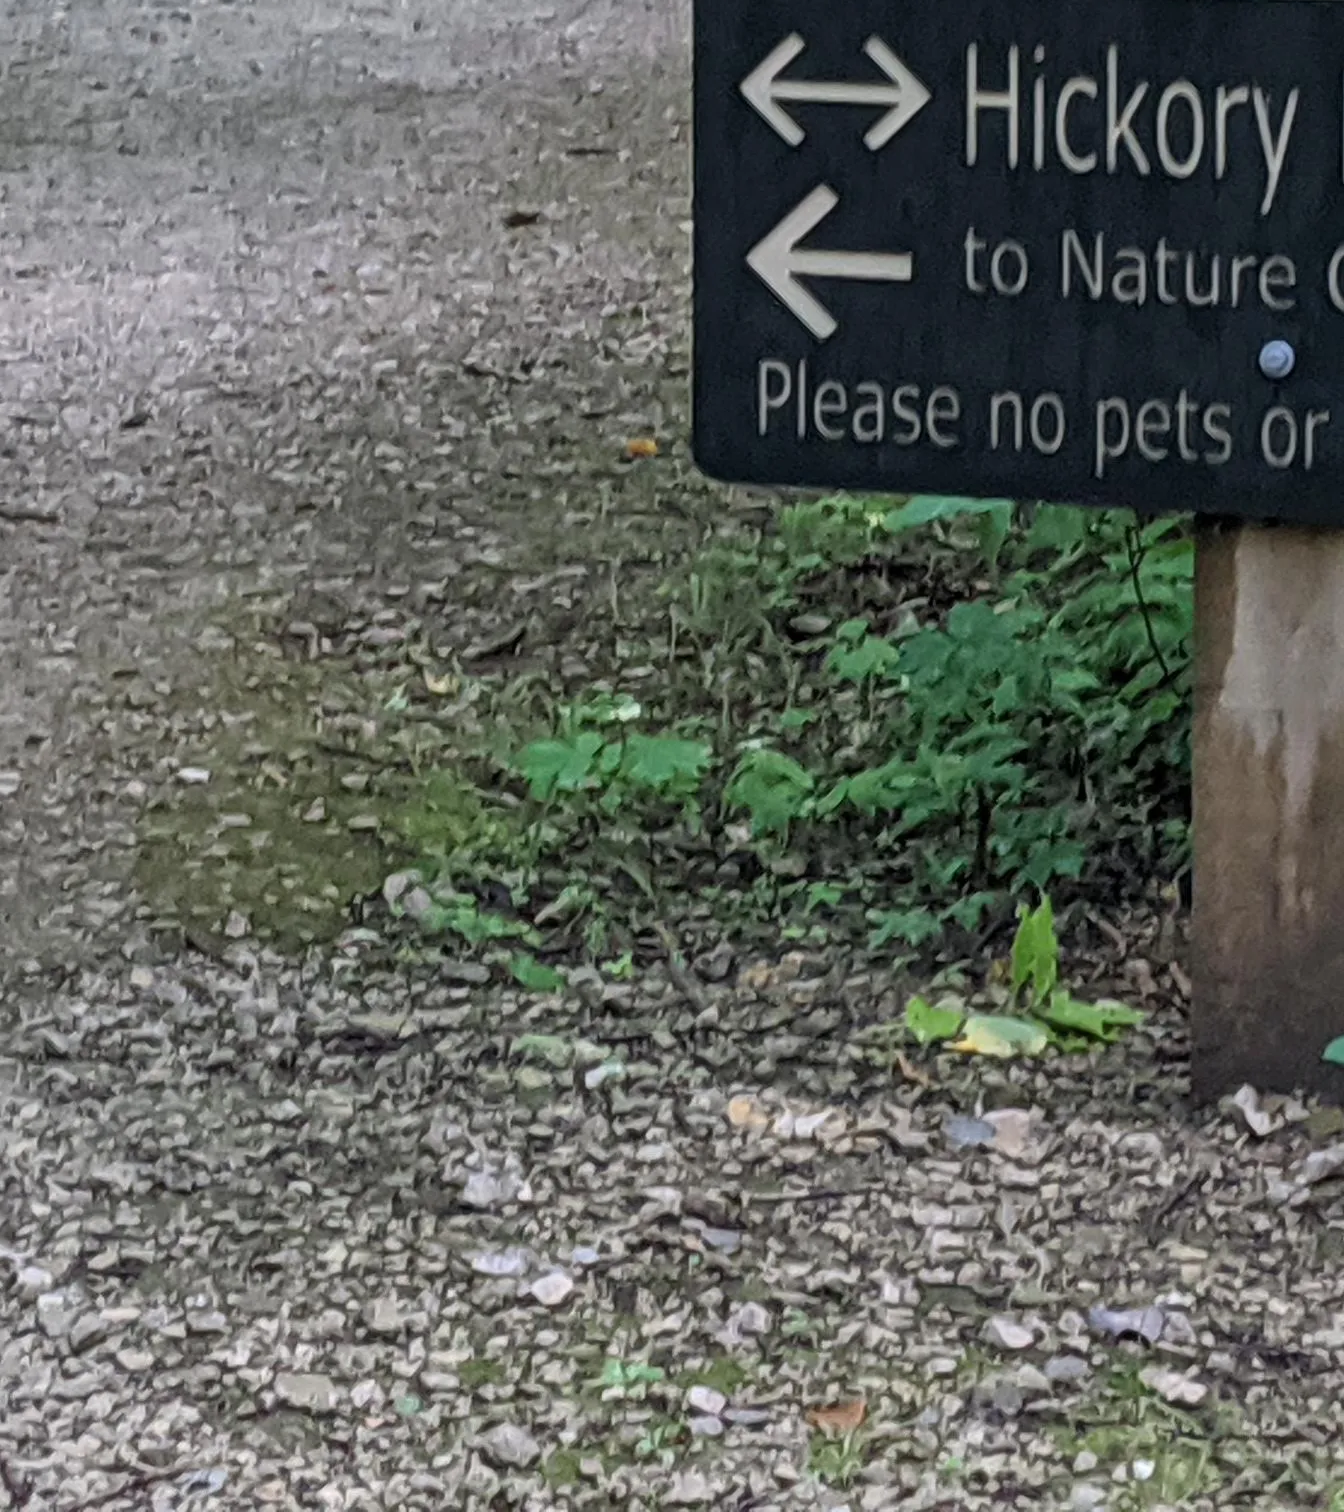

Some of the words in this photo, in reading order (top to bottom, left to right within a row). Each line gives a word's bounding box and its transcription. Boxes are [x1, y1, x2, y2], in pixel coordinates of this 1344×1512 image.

[966, 43, 1299, 216] Hickory
[964, 226, 1028, 294] to
[1062, 229, 1296, 308] Nature
[758, 359, 959, 447] Please
[990, 391, 1065, 453] no
[1096, 390, 1232, 477] pets
[1261, 407, 1330, 469] or
